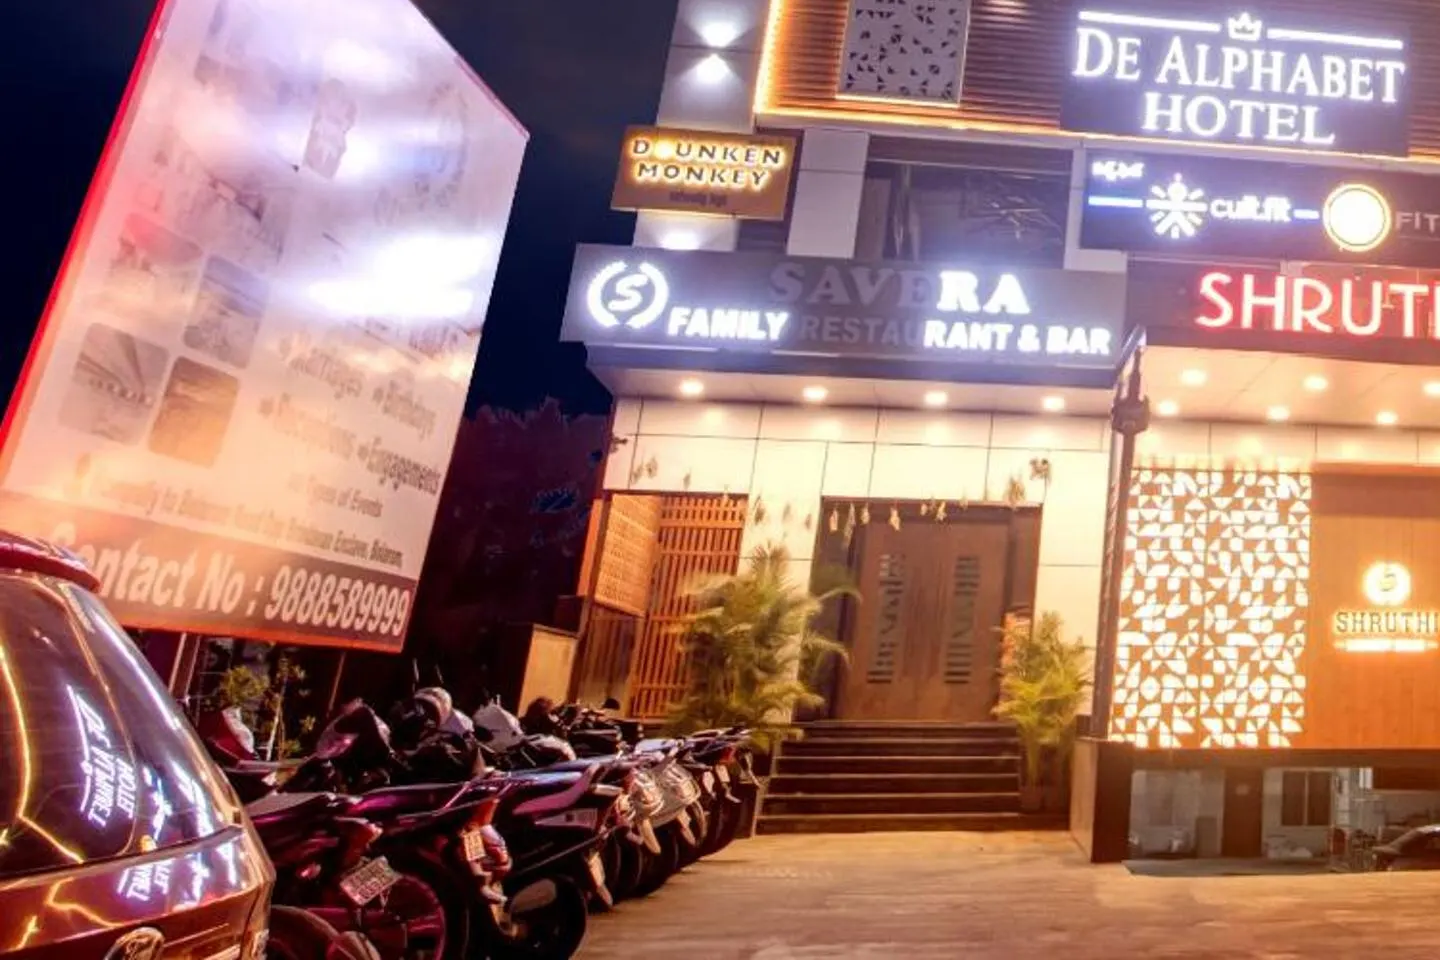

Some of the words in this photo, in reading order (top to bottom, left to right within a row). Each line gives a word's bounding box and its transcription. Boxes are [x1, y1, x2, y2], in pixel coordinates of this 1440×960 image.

[1072, 27, 1141, 81] DE
[1155, 36, 1405, 104] ALPHABET
[1141, 91, 1335, 145] HOTEL
[633, 139, 780, 164] DUNKEN
[638, 163, 767, 185] MONKEY
[769, 261, 1030, 315] SAVERA
[667, 306, 790, 341] FAMILY
[804, 315, 1014, 351] RESTAURANT
[1017, 324, 1040, 353] &
[1046, 324, 1112, 356] BAR
[196, 551, 245, 614] No
[264, 565, 411, 636] 9888589999
[1336, 611, 1440, 634] SHRUTHI
